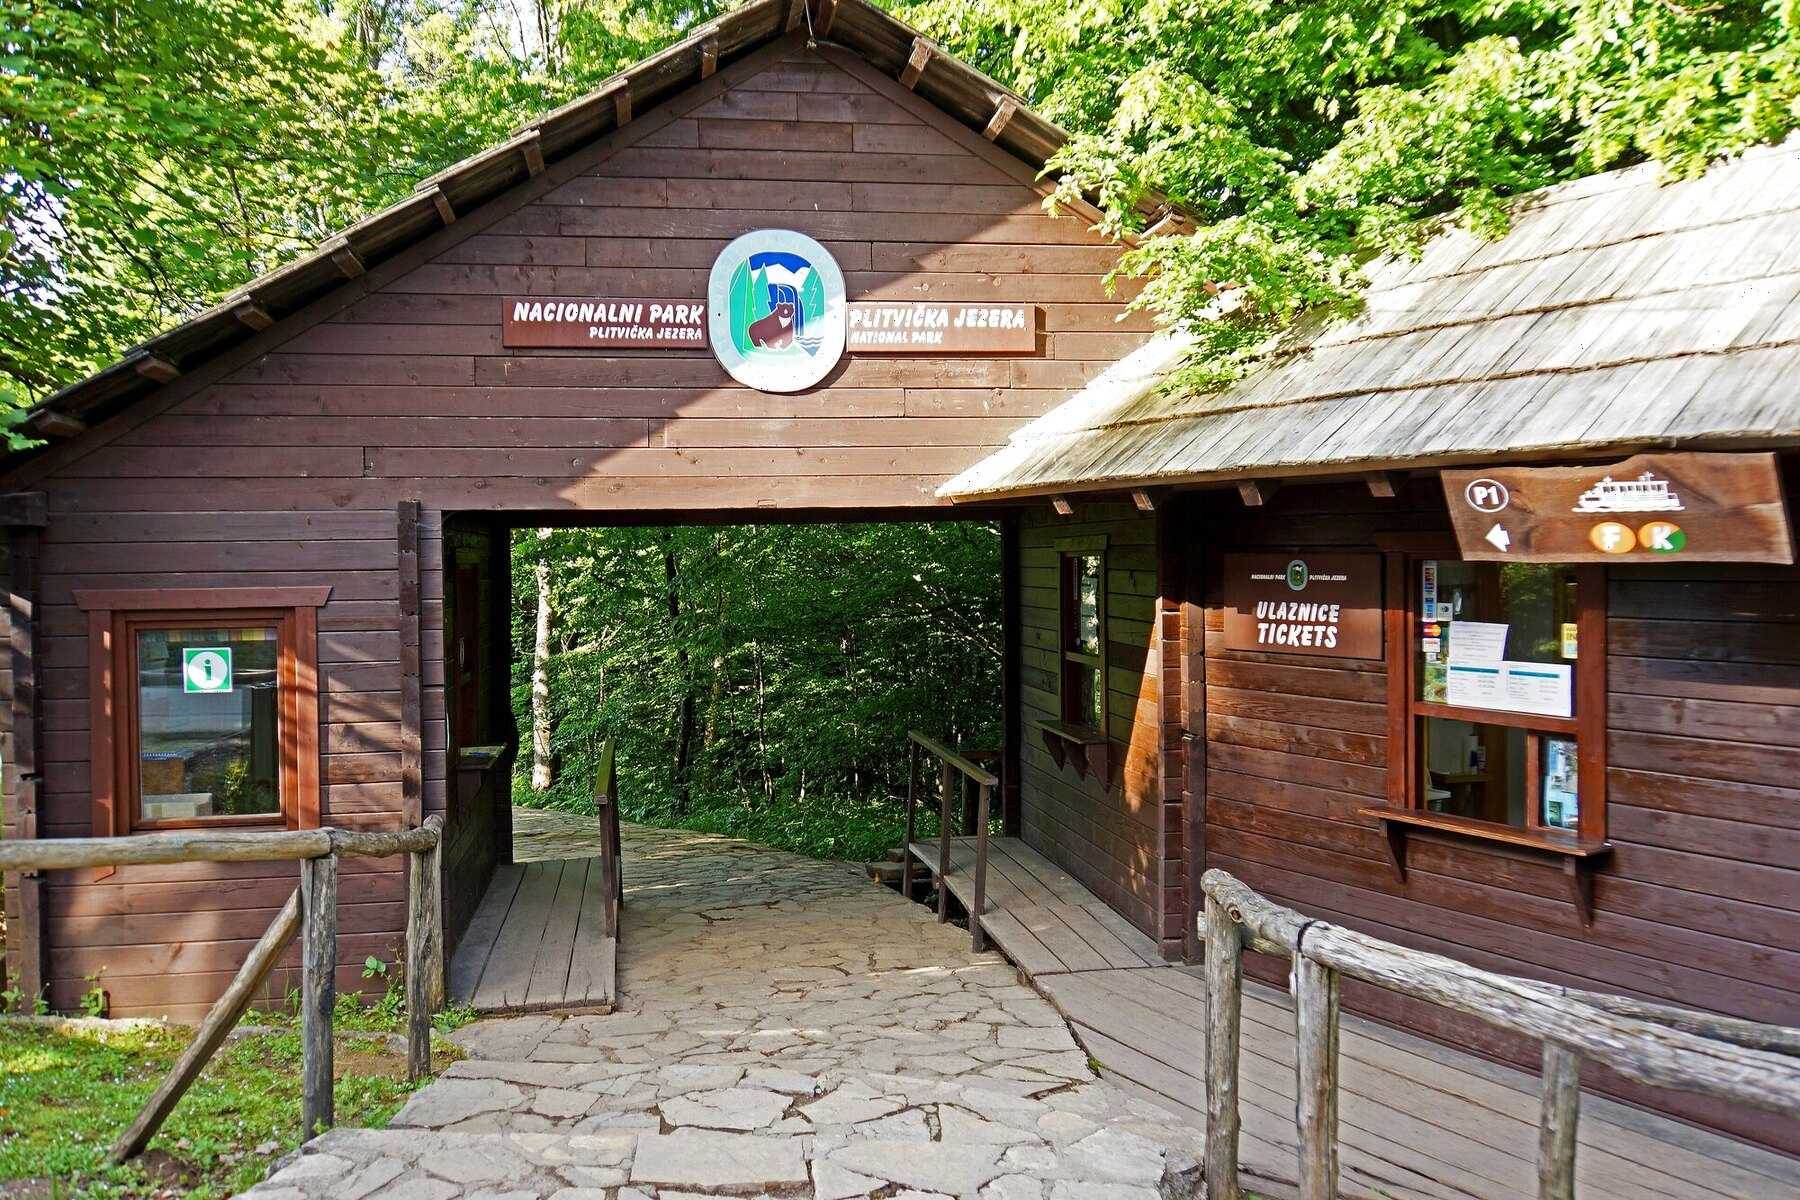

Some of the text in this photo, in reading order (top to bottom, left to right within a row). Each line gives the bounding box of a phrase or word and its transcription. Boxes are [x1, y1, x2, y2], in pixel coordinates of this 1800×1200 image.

[513, 302, 704, 325] NACIONALNI PARK
[849, 305, 1026, 329] PLITVIČKA JEZERA
[589, 325, 703, 340] PLITVIČKA JEZERA
[850, 331, 944, 344] NATIONAL PARK
[1473, 486, 1501, 505] P1
[1602, 525, 1621, 549] F
[1652, 525, 1674, 550] K
[1256, 601, 1340, 623] ULAZNICE
[1257, 623, 1338, 648] TICKETS
